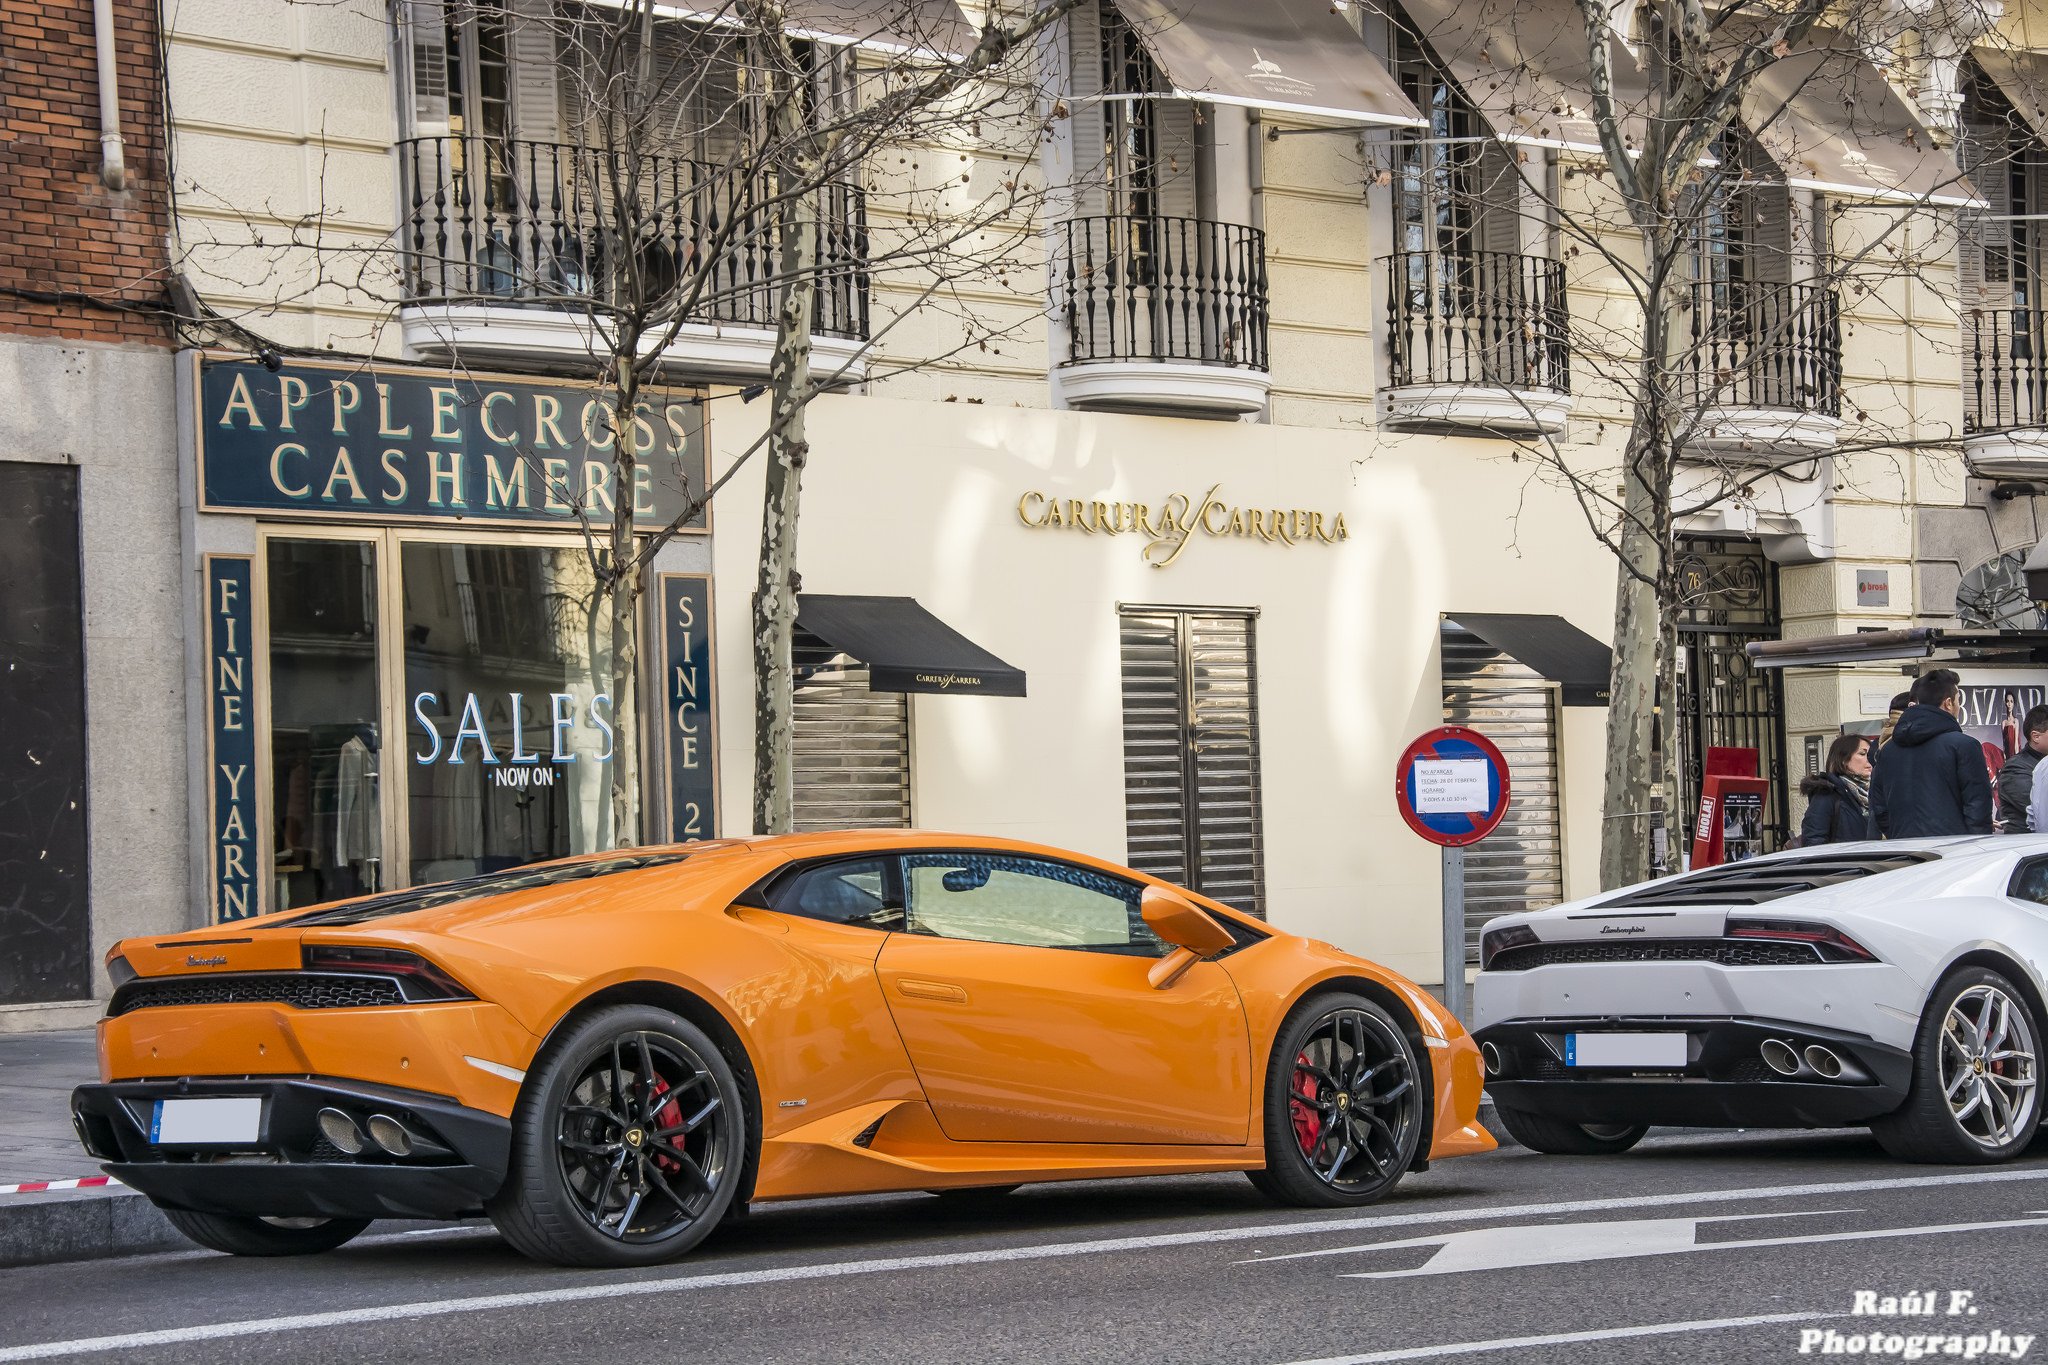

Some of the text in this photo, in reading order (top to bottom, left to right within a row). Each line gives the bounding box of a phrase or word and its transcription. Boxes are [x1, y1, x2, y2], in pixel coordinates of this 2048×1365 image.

[219, 372, 690, 455] APPLECROSS
[269, 442, 657, 518] CASHMERE
[1201, 500, 1351, 547] CARRERA
[1687, 572, 1701, 590] 76
[1867, 582, 1888, 591] brosh
[219, 578, 244, 732] FINE
[676, 596, 699, 769] SINCE
[414, 692, 613, 764] SALES
[495, 767, 554, 787] NOW ON
[220, 764, 250, 919] YARN
[684, 802, 702, 842] 2
[1600, 925, 1646, 935] Lamborghini
